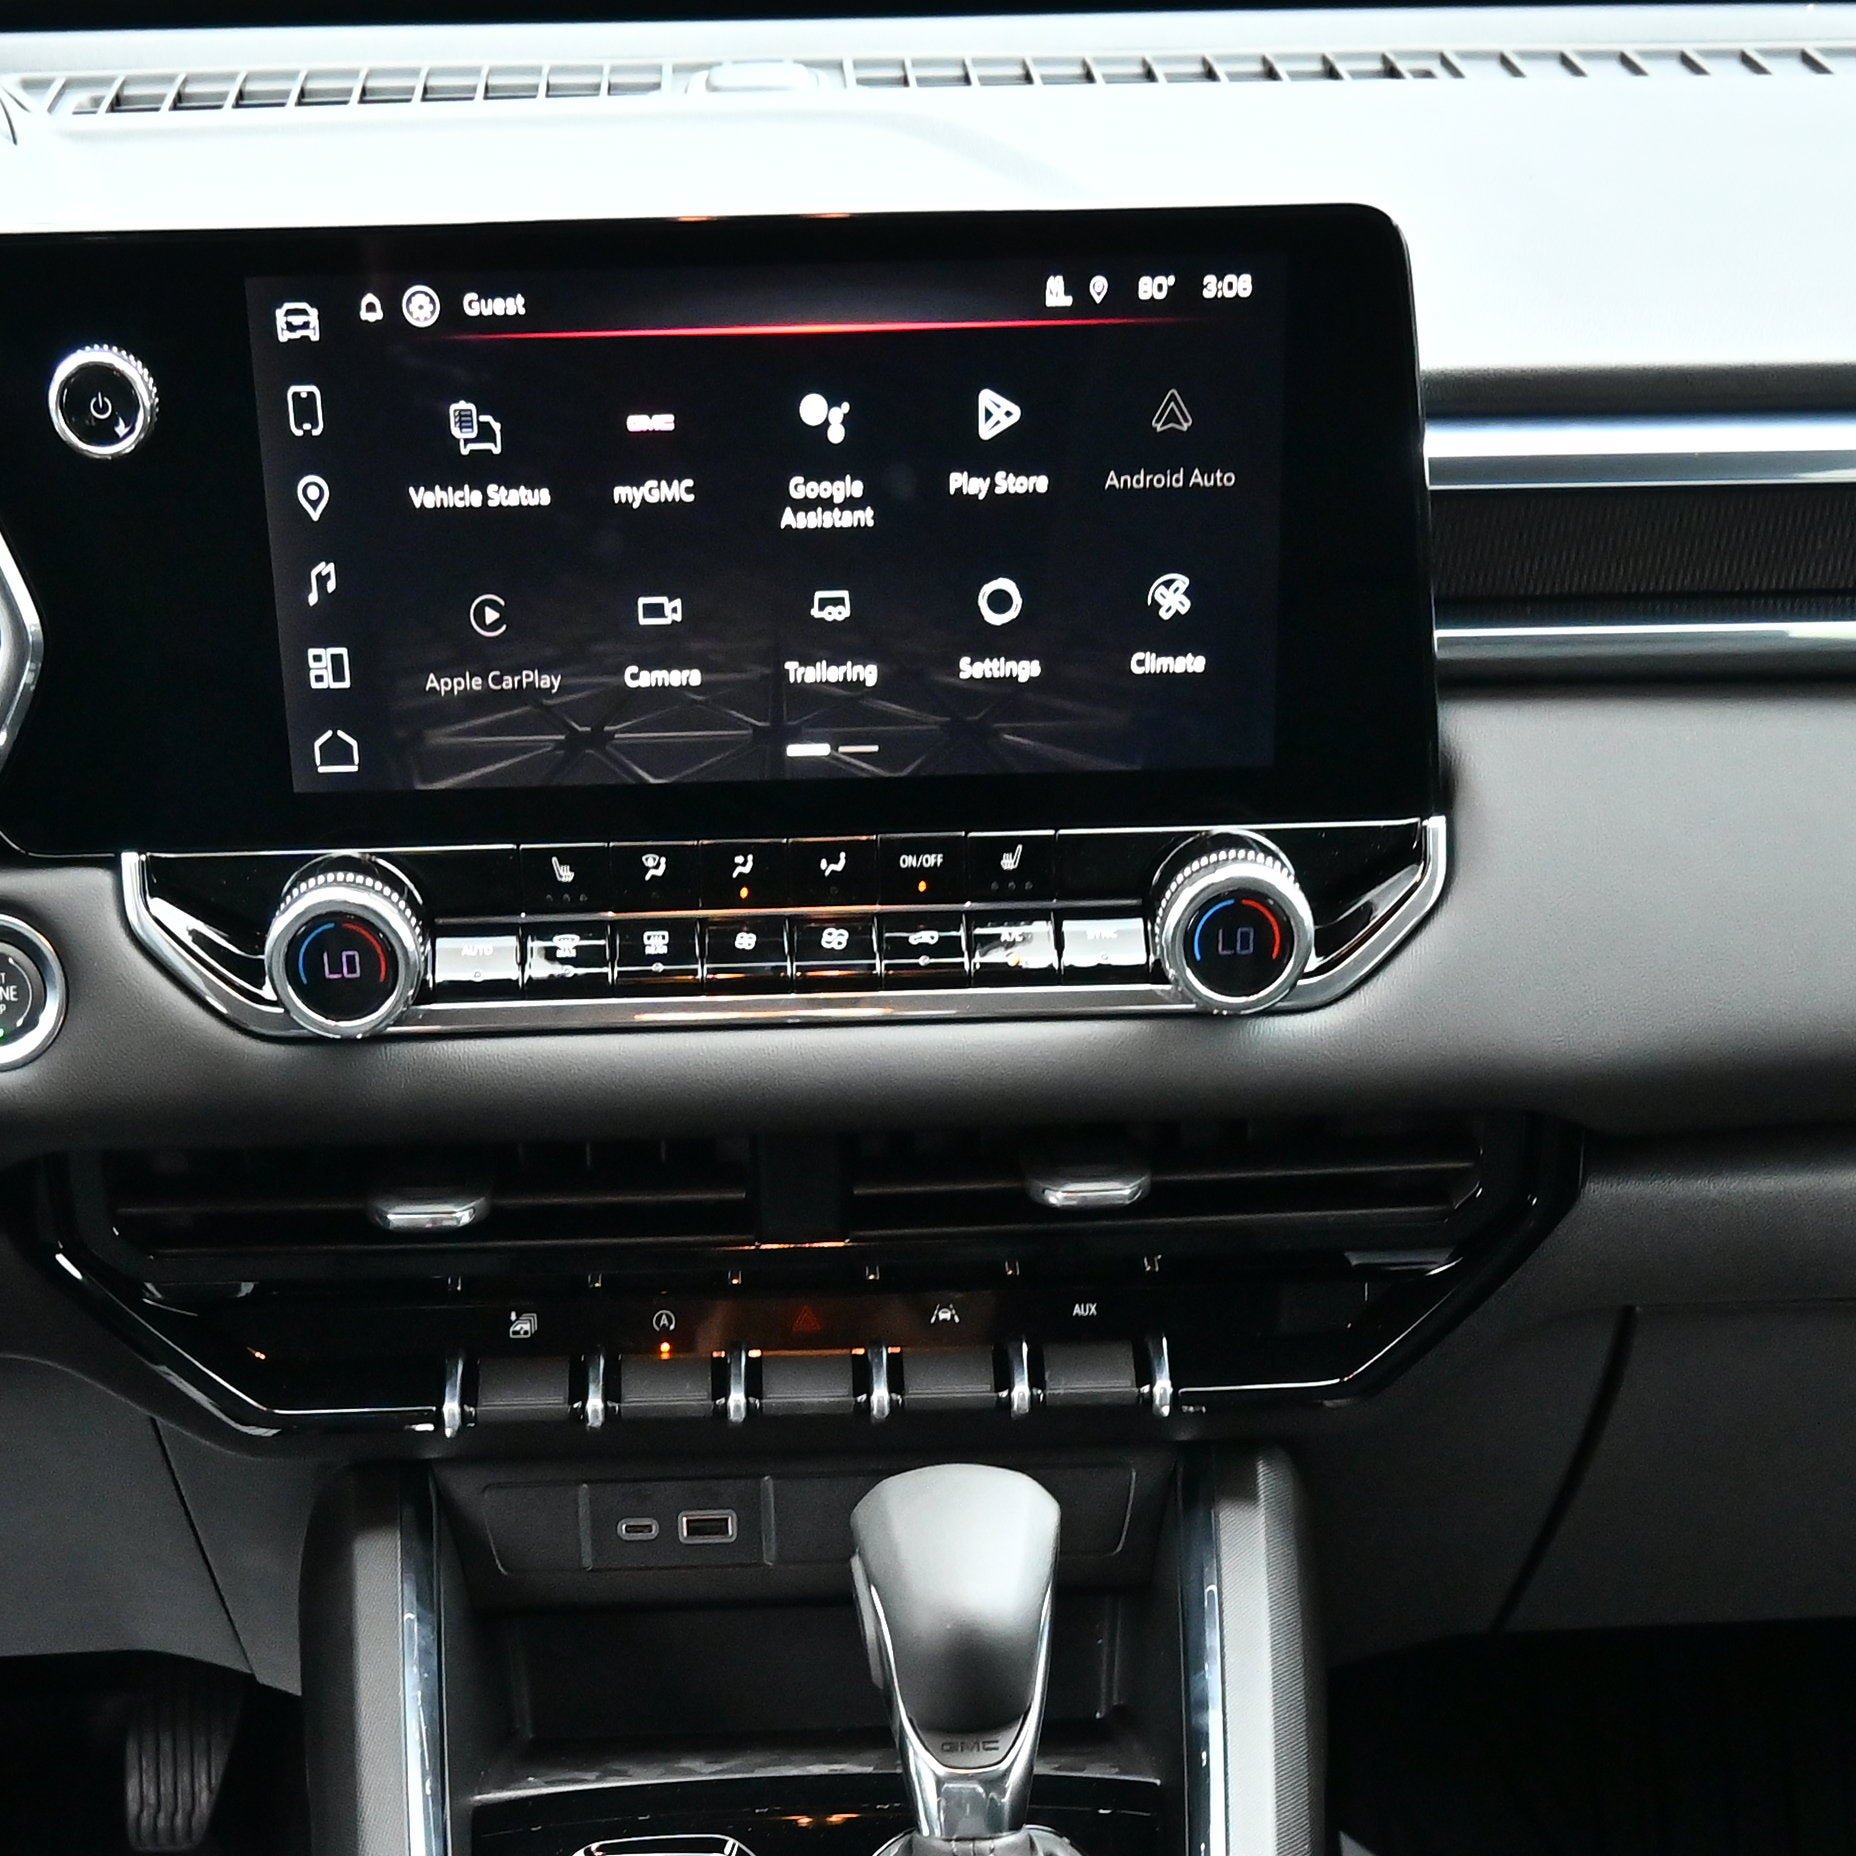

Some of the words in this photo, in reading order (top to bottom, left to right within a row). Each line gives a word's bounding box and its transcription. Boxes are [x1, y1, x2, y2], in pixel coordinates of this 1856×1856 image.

[462, 292, 526, 316] Guest
[788, 475, 864, 504] Google
[949, 471, 990, 501] Play
[994, 470, 1050, 494] Store
[1104, 469, 1184, 491] Android
[1189, 468, 1236, 488] Auto
[408, 484, 483, 509] Vehicle
[486, 484, 552, 507] Status
[613, 479, 696, 509] myGMC
[779, 506, 875, 530] Assistant
[784, 660, 879, 687] Trailering
[958, 656, 1042, 683] Settings
[1130, 652, 1207, 675] Climate
[425, 670, 483, 696] Apple
[487, 669, 562, 693] CarPlay
[623, 665, 703, 689] Camera
[899, 853, 943, 869] ON/OFF
[1217, 927, 1255, 955] LO
[323, 950, 360, 979] LO
[1072, 1303, 1097, 1318] AUX
